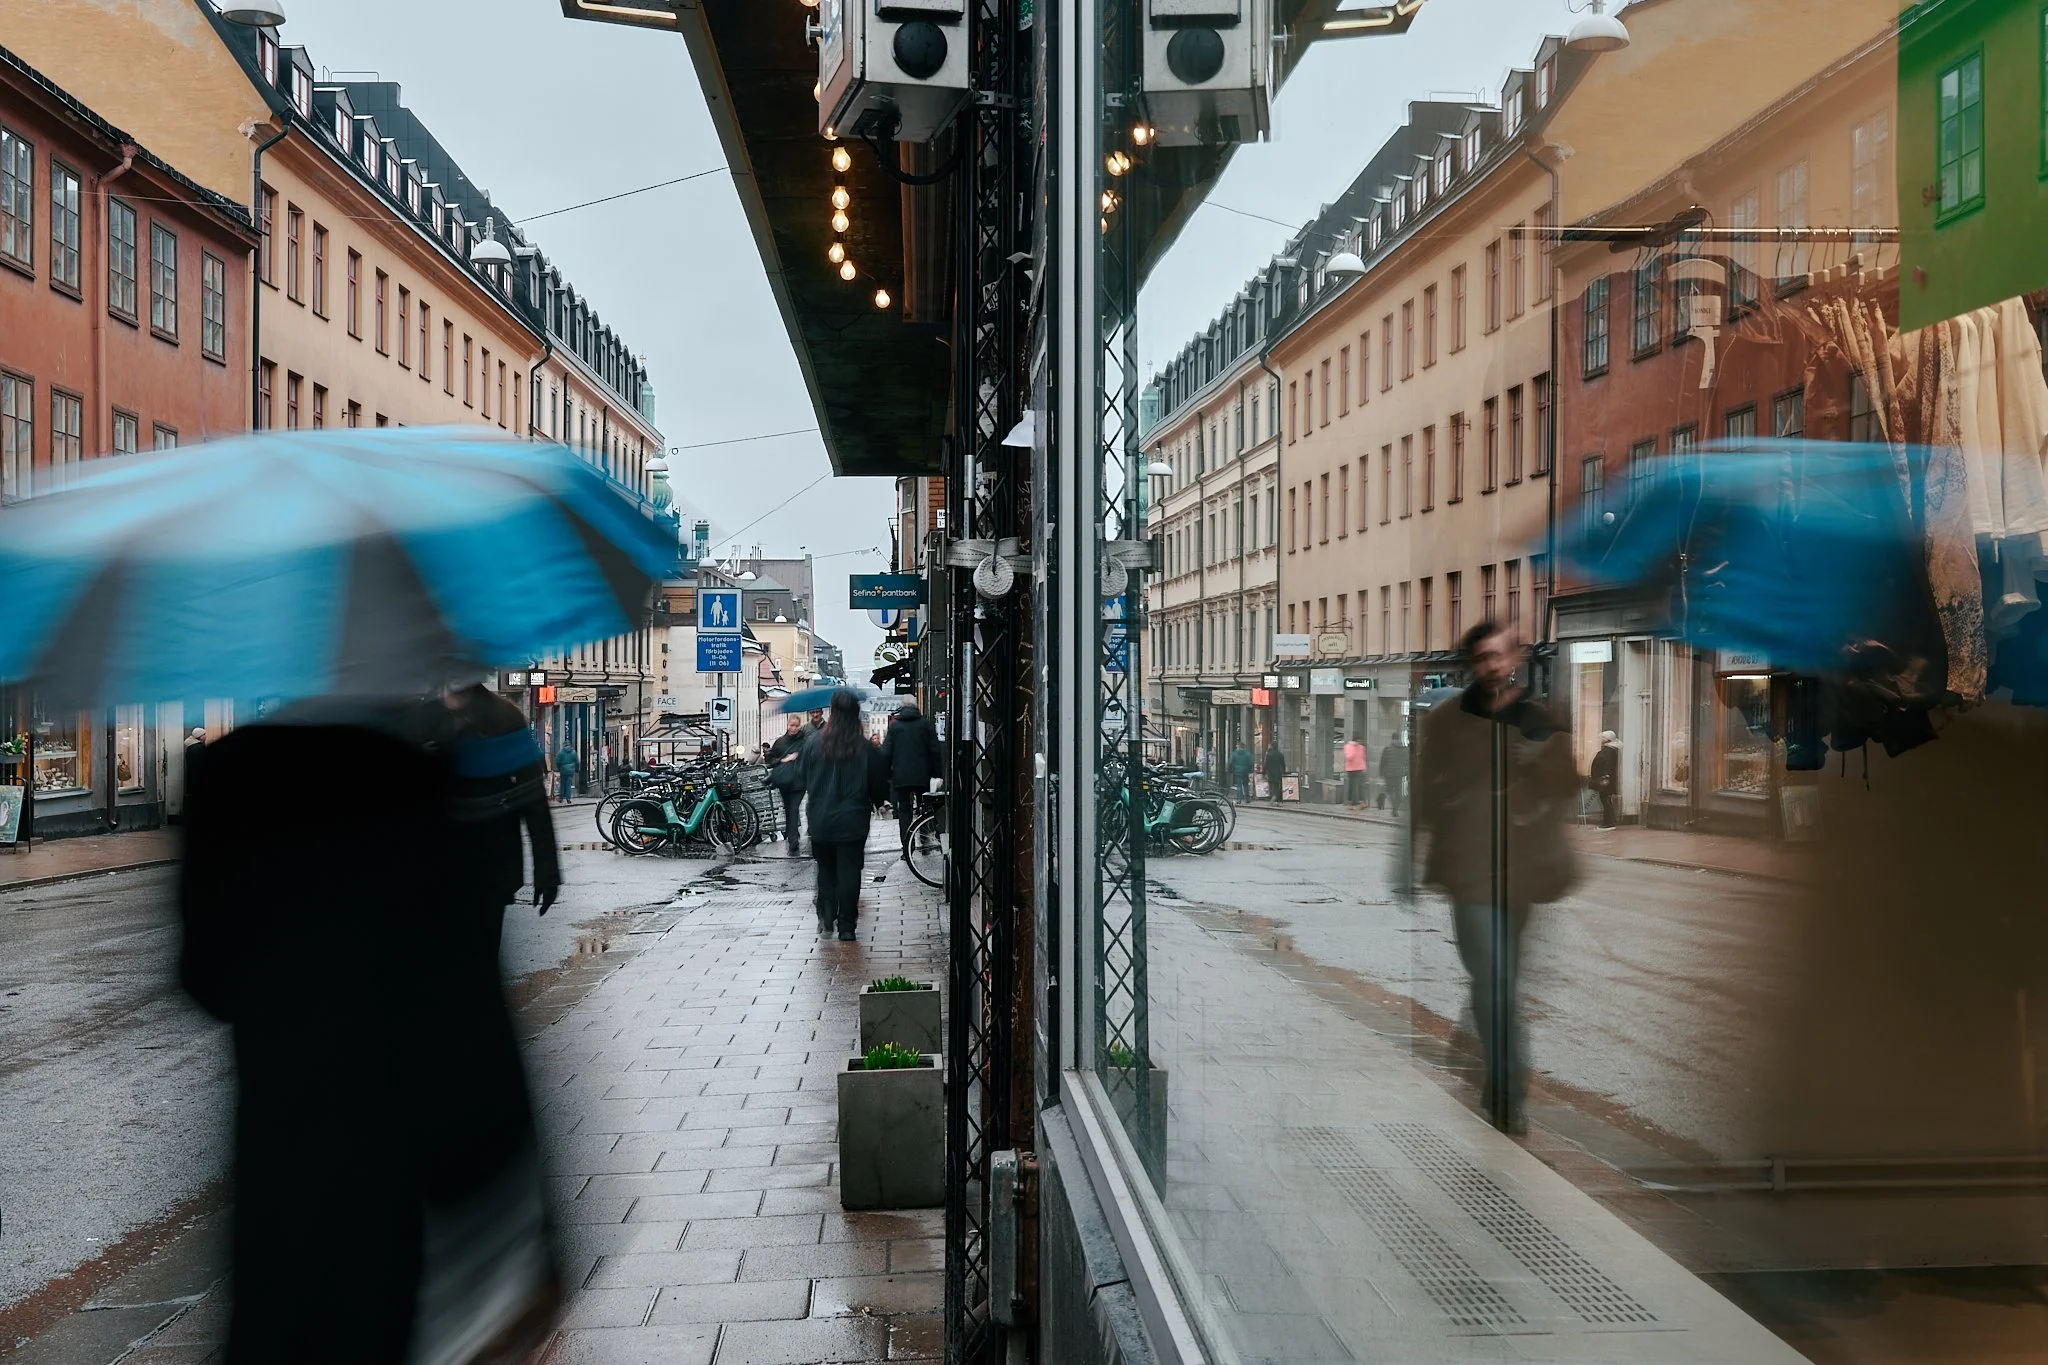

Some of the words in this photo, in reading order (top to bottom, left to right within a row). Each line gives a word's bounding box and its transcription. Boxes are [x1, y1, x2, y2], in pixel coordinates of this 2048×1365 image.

[1921, 179, 1947, 207] SALE
[853, 589, 877, 597] Sefina
[882, 589, 917, 598] pantbank
[876, 641, 905, 655] ESPRESSO
[657, 697, 677, 705] FACE
